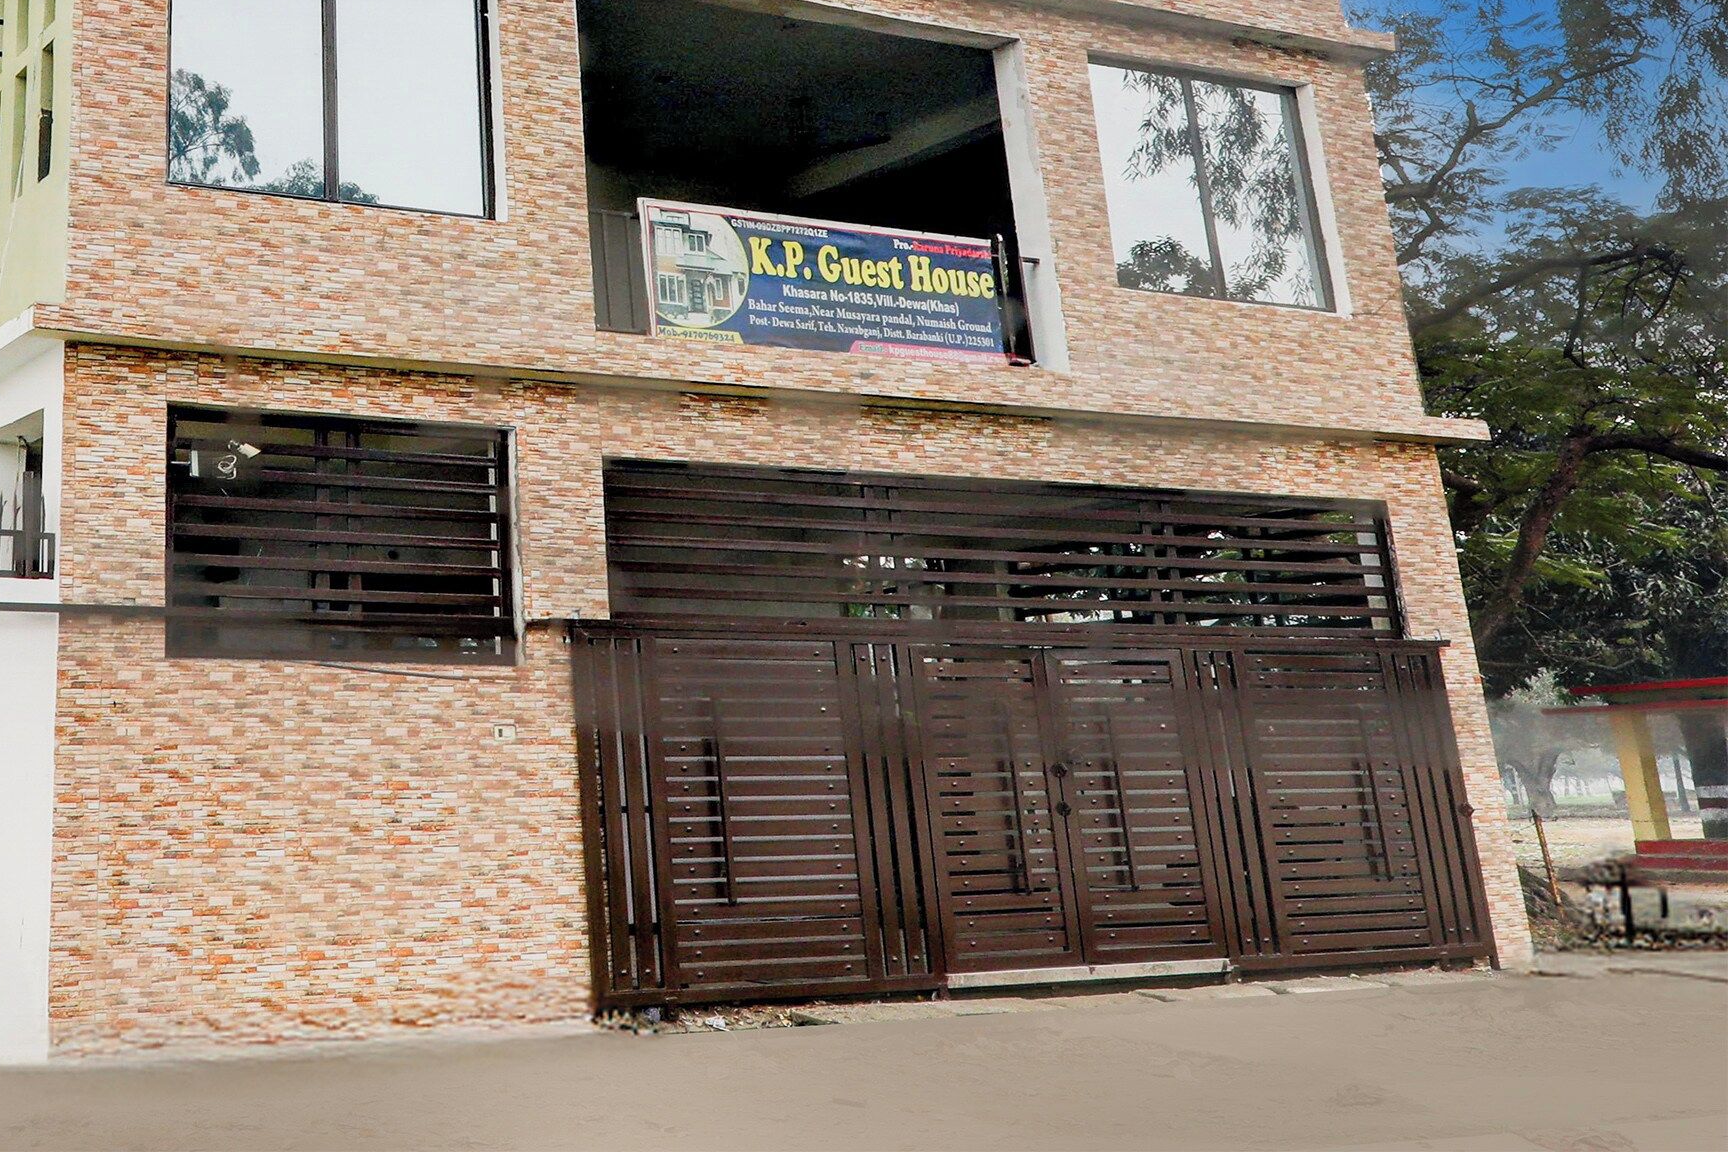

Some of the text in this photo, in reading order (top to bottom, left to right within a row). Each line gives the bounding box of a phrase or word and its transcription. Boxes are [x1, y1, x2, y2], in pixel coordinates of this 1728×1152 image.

[748, 236, 994, 299] K.P. Guest House
[782, 284, 828, 300] Khasara
[748, 299, 777, 312] Bahar
[836, 308, 881, 324] Musayara
[882, 313, 915, 327] pandal,
[916, 316, 957, 330] Numaish
[957, 319, 992, 333] Ground
[772, 317, 794, 328] Dewa
[795, 319, 817, 332] Sarif,
[817, 321, 836, 333] Teh.
[883, 327, 905, 339] Distt.
[906, 329, 944, 343] Barabanki
